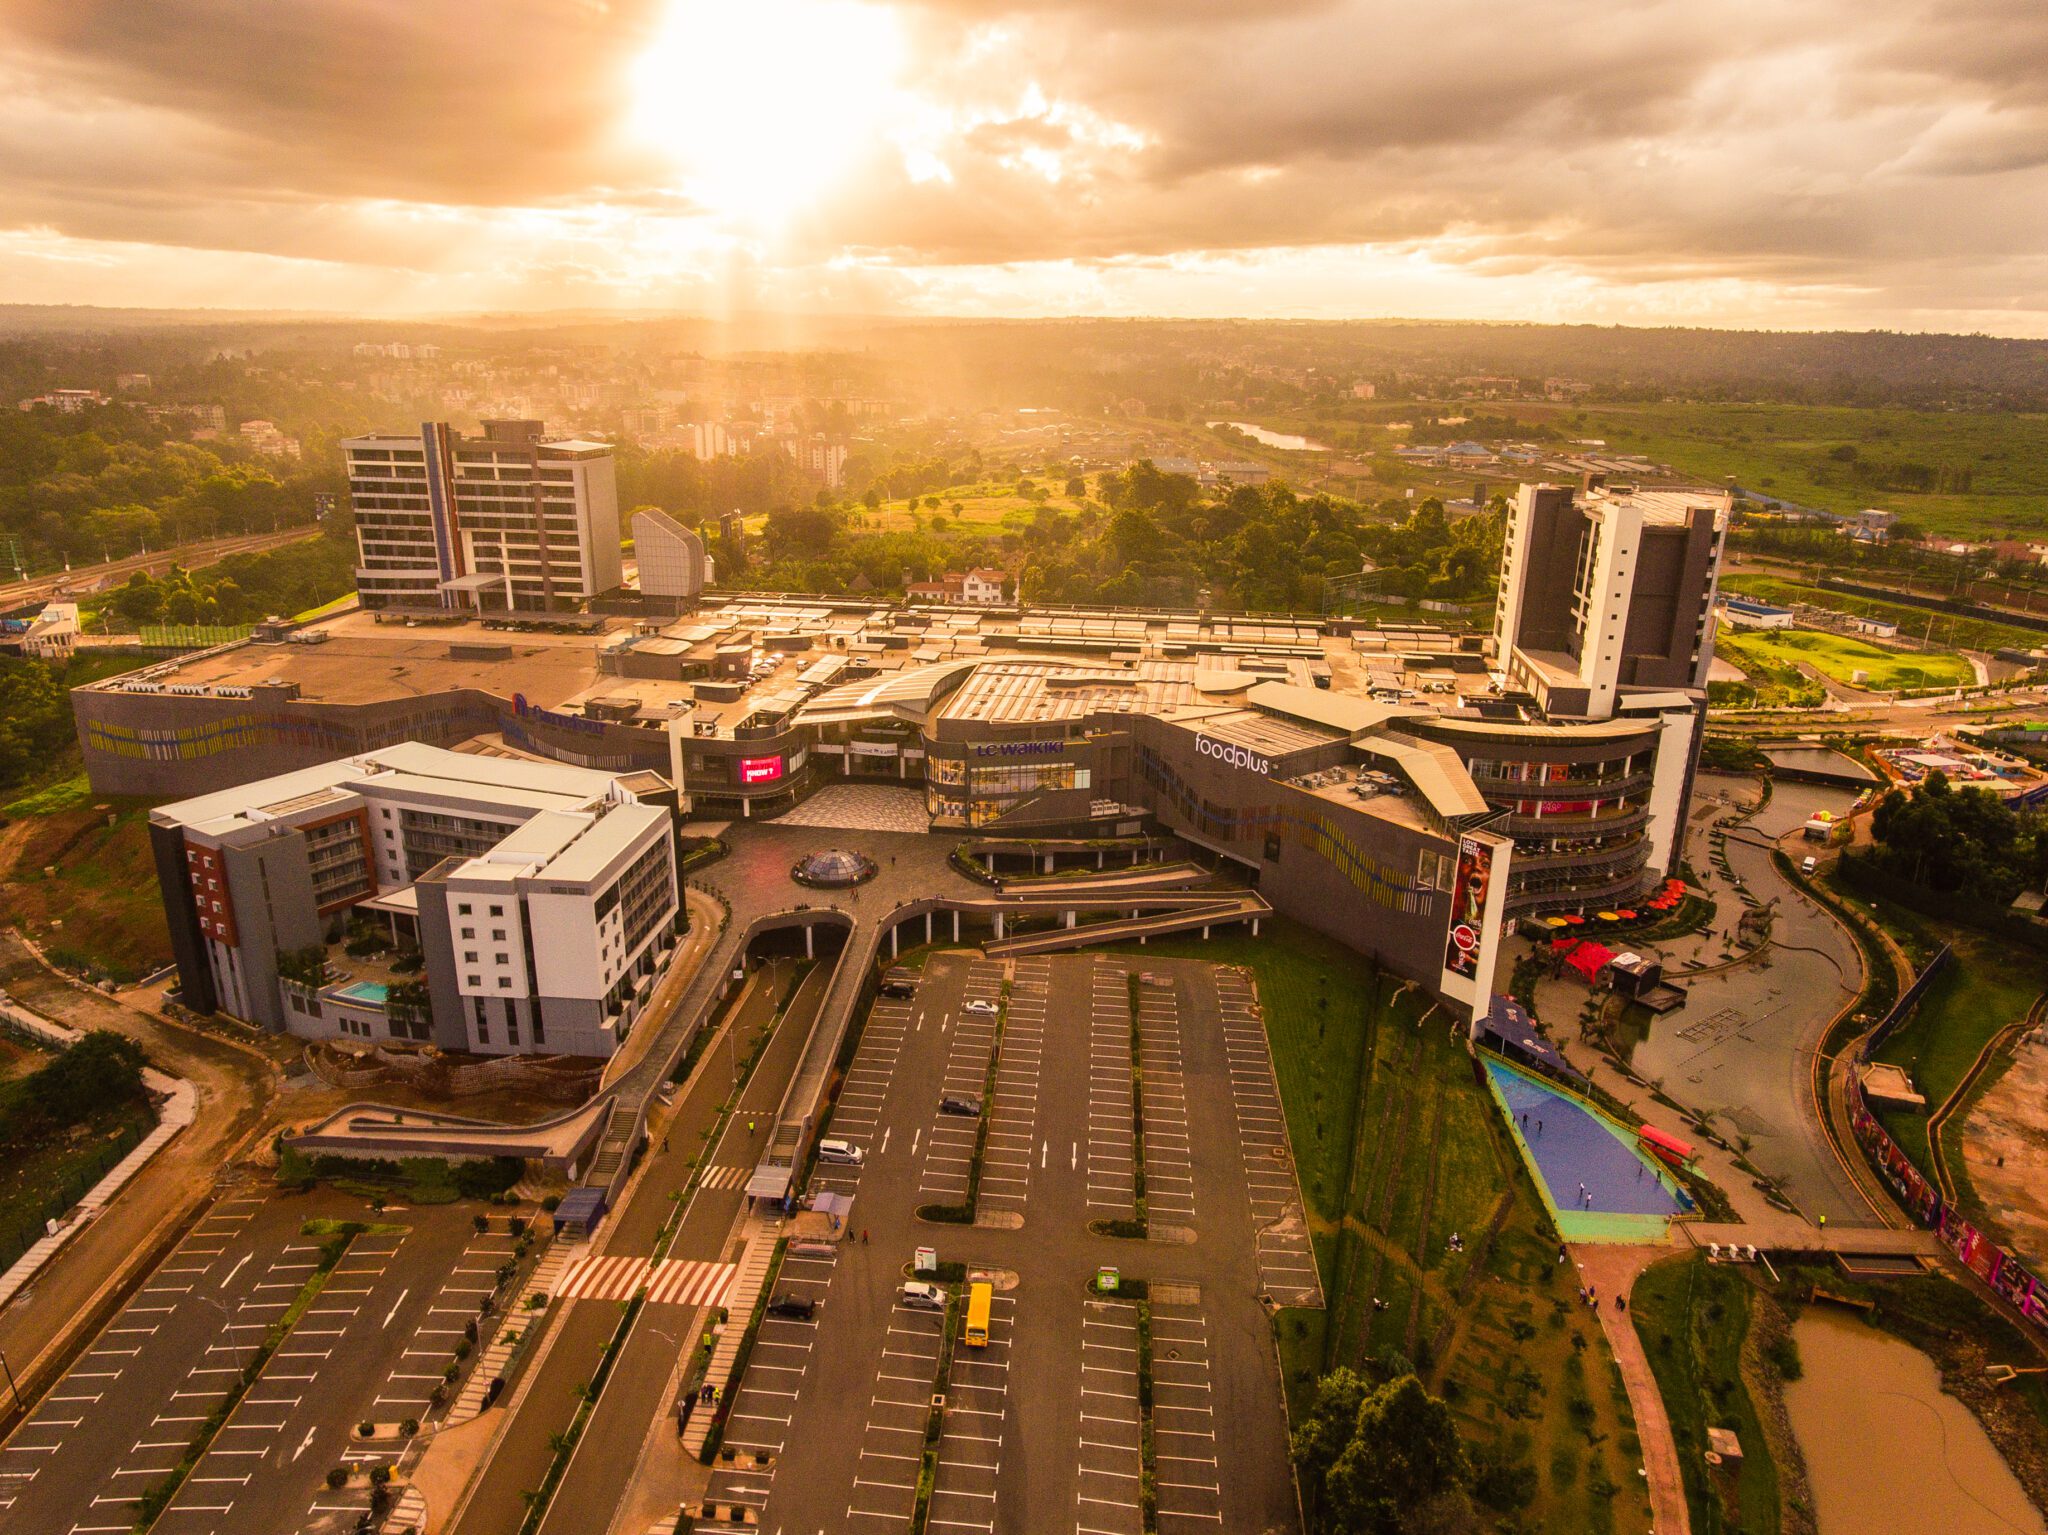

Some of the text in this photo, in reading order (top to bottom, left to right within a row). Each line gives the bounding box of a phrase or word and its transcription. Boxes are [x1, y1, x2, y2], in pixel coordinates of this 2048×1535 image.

[977, 744, 998, 757] LC
[1195, 732, 1268, 774] foodplus
[1463, 839, 1478, 847] LOVE
[1463, 844, 1480, 853] GREAT
[1463, 848, 1479, 857] TASTE
